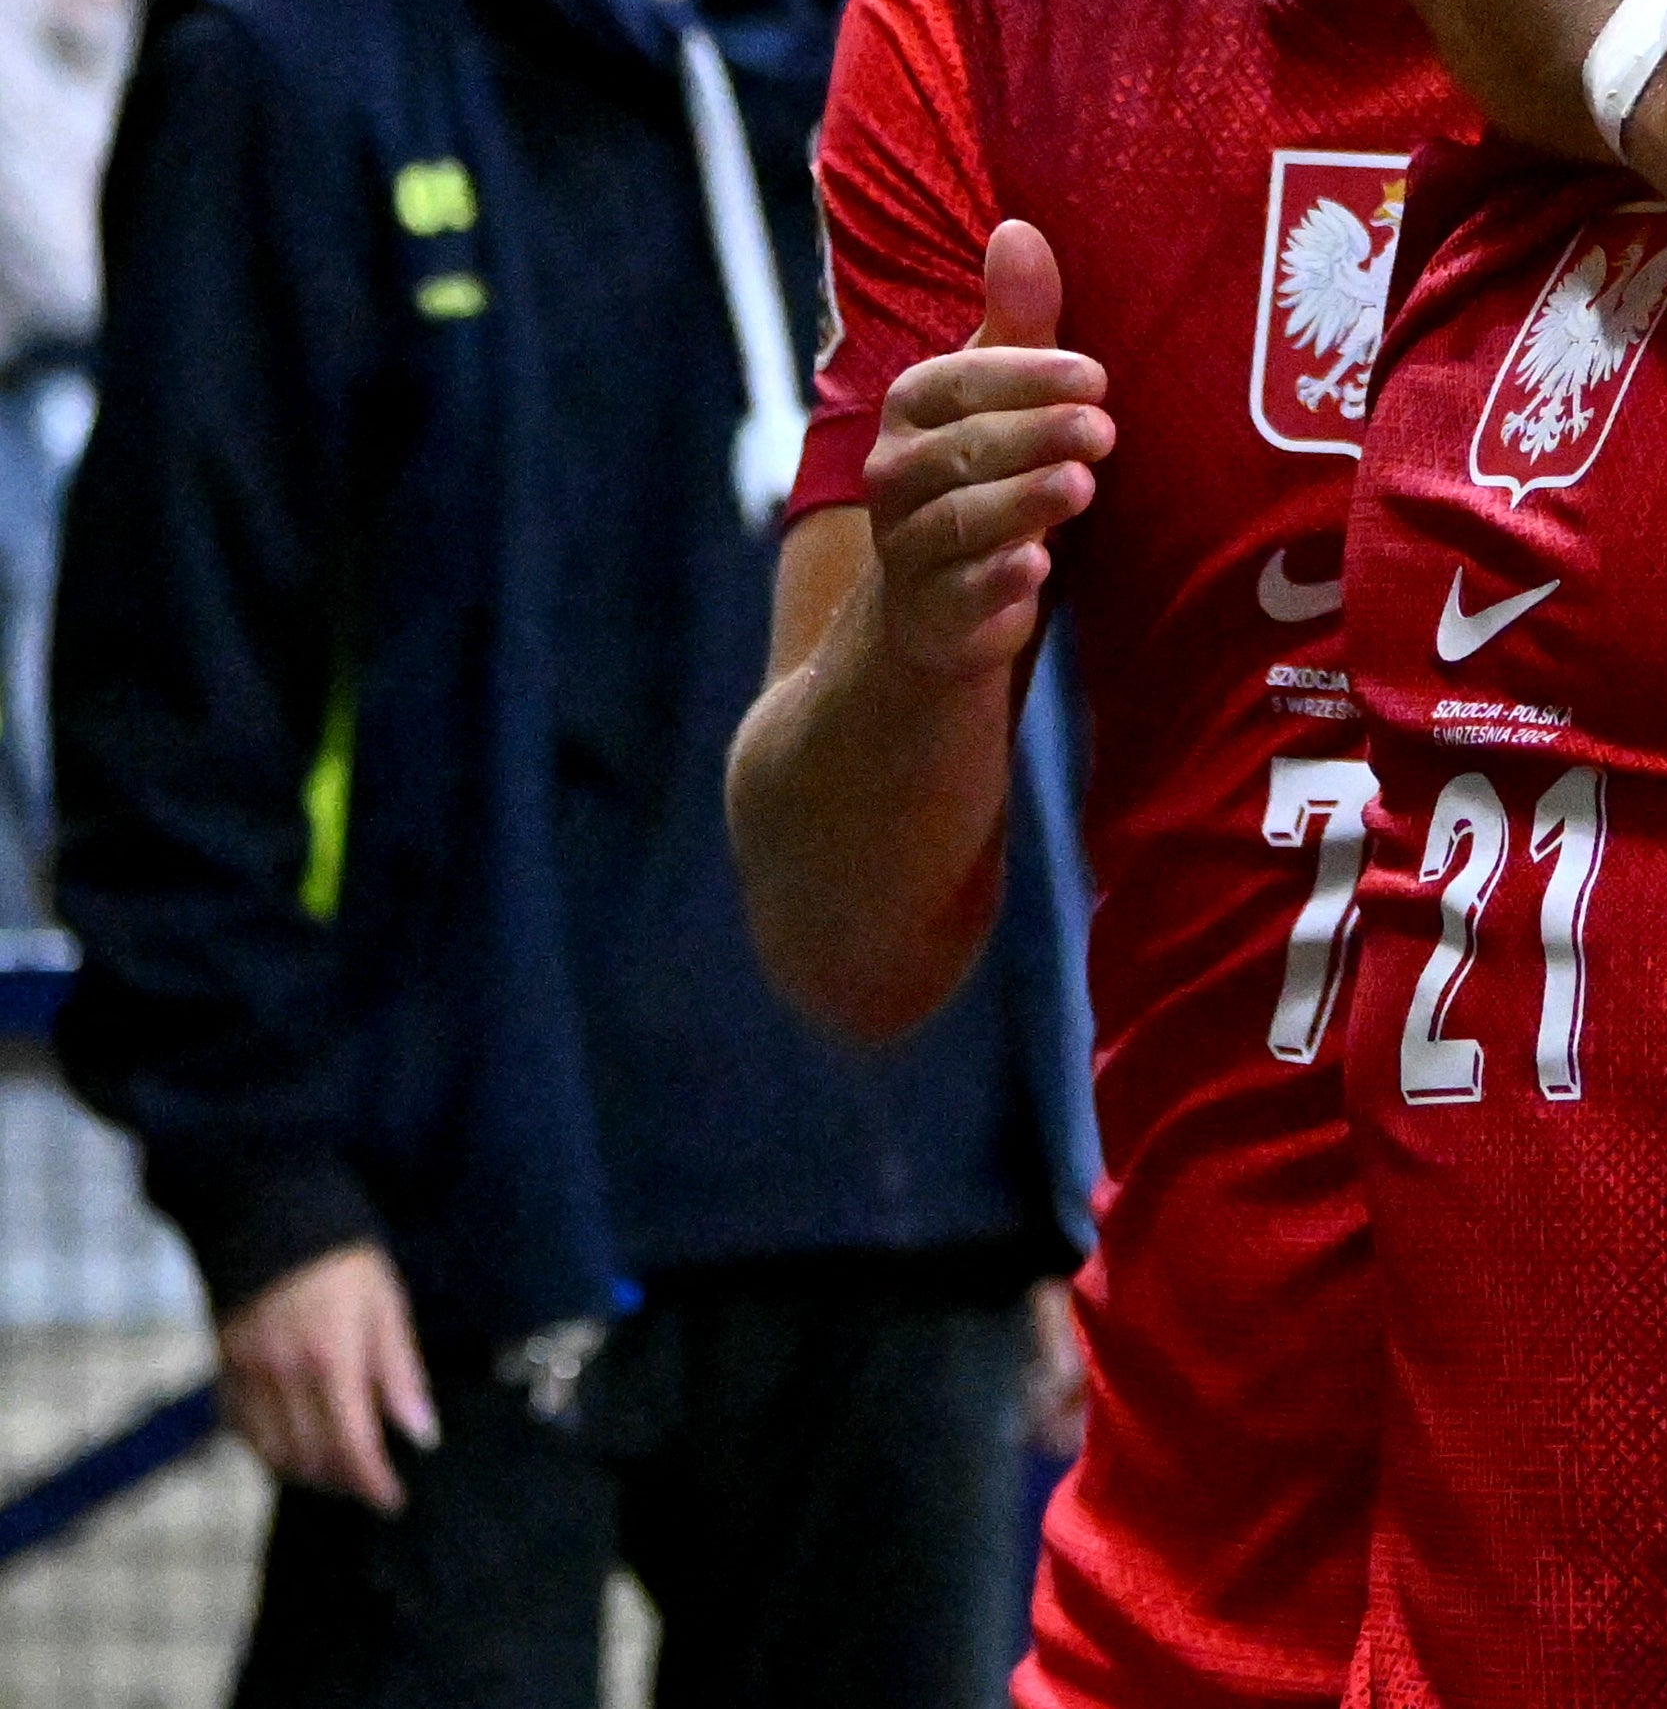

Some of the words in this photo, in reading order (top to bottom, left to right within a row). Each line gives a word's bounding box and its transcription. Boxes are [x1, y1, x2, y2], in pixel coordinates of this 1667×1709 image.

[1432, 699, 1504, 720] SZKOCJA
[1507, 704, 1573, 727] POLSKA
[1511, 728, 1562, 744] 2024
[1262, 757, 1379, 1064] 7
[1400, 765, 1609, 1105] 21
